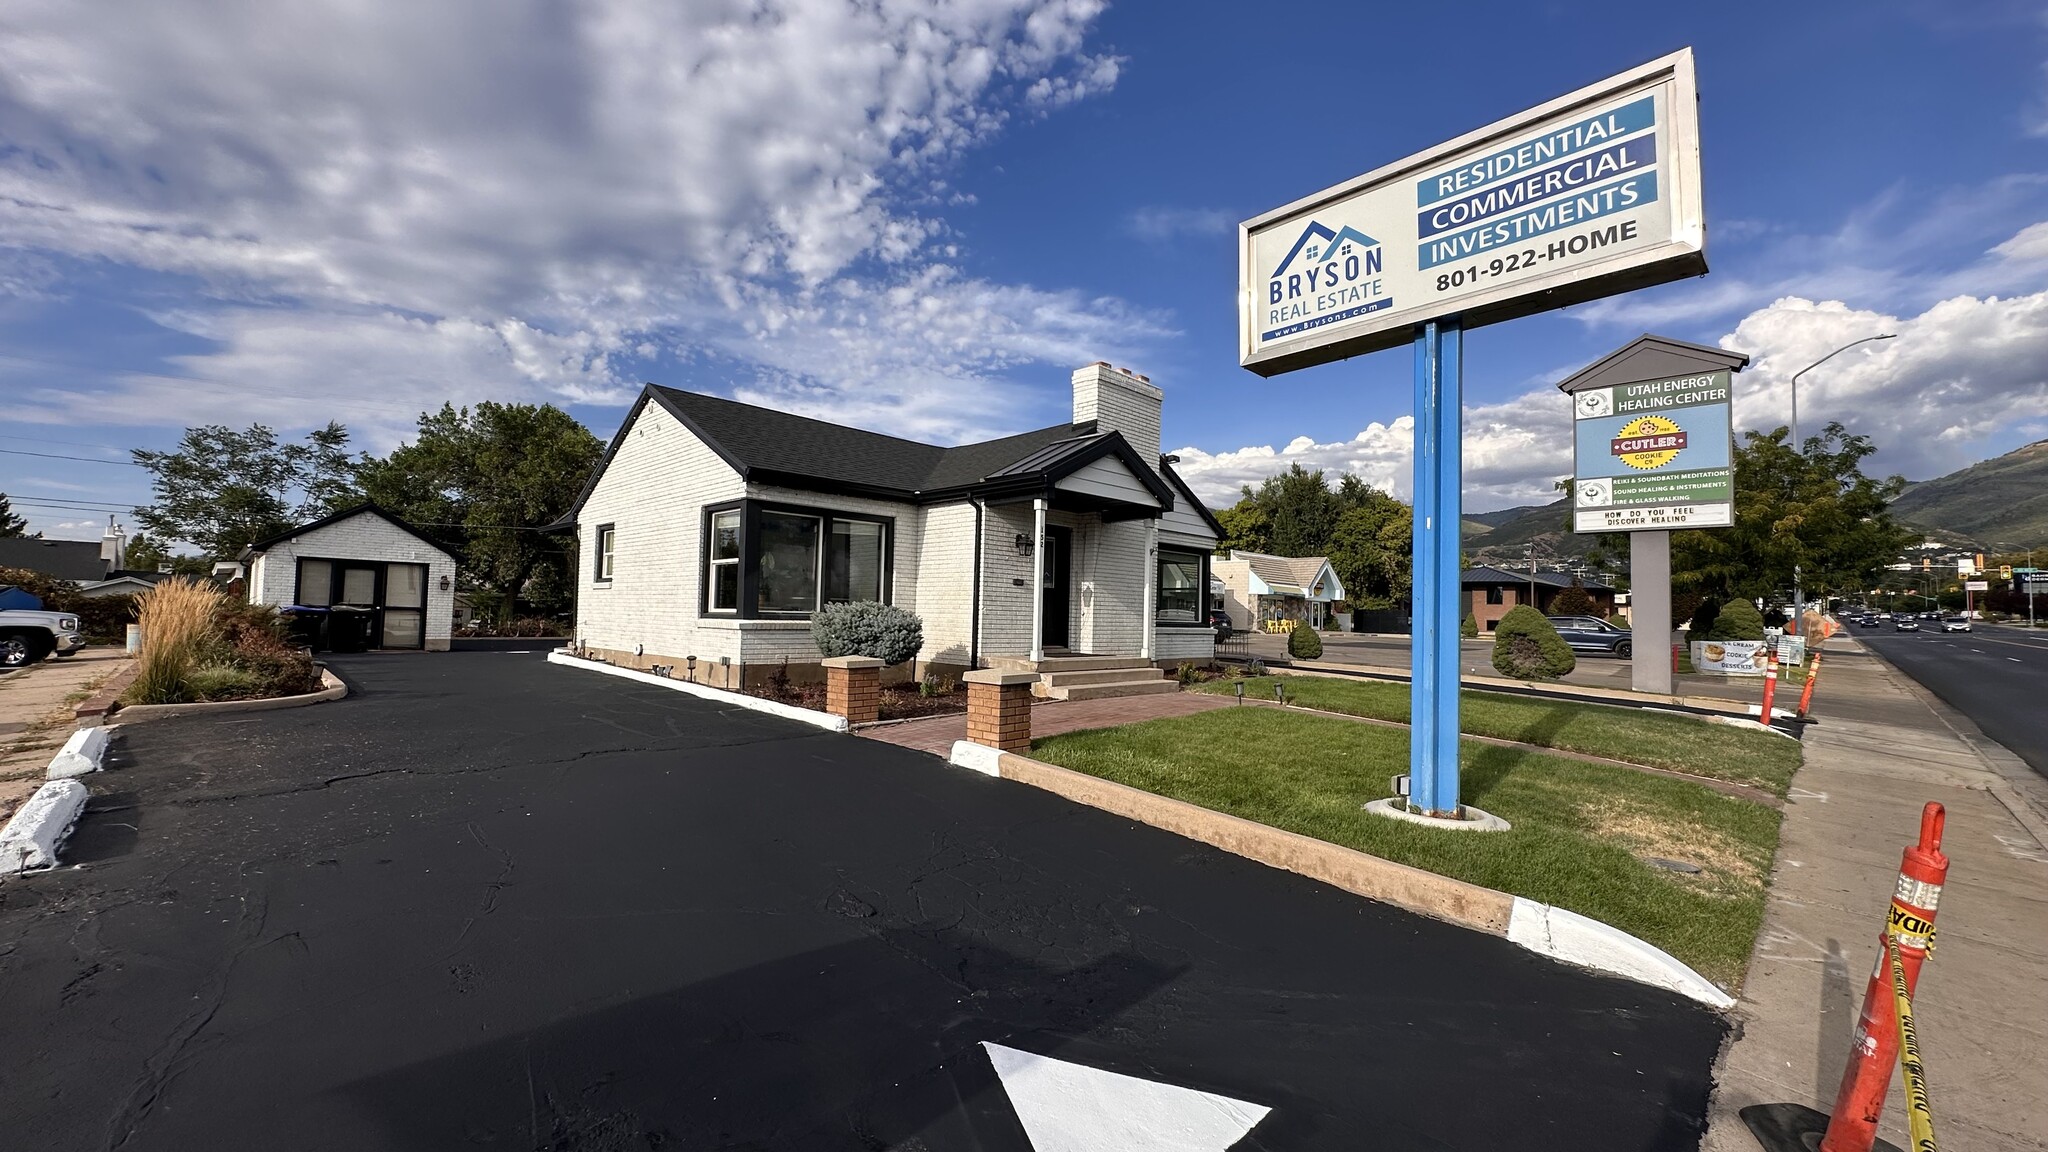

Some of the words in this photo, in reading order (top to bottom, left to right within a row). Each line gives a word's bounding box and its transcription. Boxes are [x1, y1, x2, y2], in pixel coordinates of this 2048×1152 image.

[1438, 114, 1626, 197] RESIDENTIAL
[1431, 147, 1637, 230] COMMERCIAL
[1431, 181, 1638, 263] INVESTMENTS
[1436, 219, 1638, 292] 801-922-HOME
[1269, 246, 1382, 305] BRYSON
[1270, 300, 1311, 325] REAL
[1317, 278, 1382, 311] ESTATE
[1274, 303, 1378, 338] www.Brysons.com
[1627, 383, 1661, 397] UTAH
[1663, 375, 1716, 392] ENERGY
[1618, 395, 1673, 412] HEALING
[1675, 388, 1726, 404] CENTER
[1620, 436, 1677, 451] CUTLER
[1634, 452, 1664, 460] COOKIE
[1637, 474, 1680, 483] SOUNDBATH
[1680, 469, 1730, 480] MEDITATIONS
[1638, 485, 1668, 493] HEALING
[1676, 481, 1727, 490] INSTRUMENTS
[1657, 494, 1690, 502] WALKING
[1604, 511, 1622, 519] HOW
[1673, 507, 1694, 515] FEEL
[1607, 517, 1646, 526] DISCOVER
[1726, 651, 1749, 659] COOKIE
[1721, 662, 1752, 670] DESSERTS
